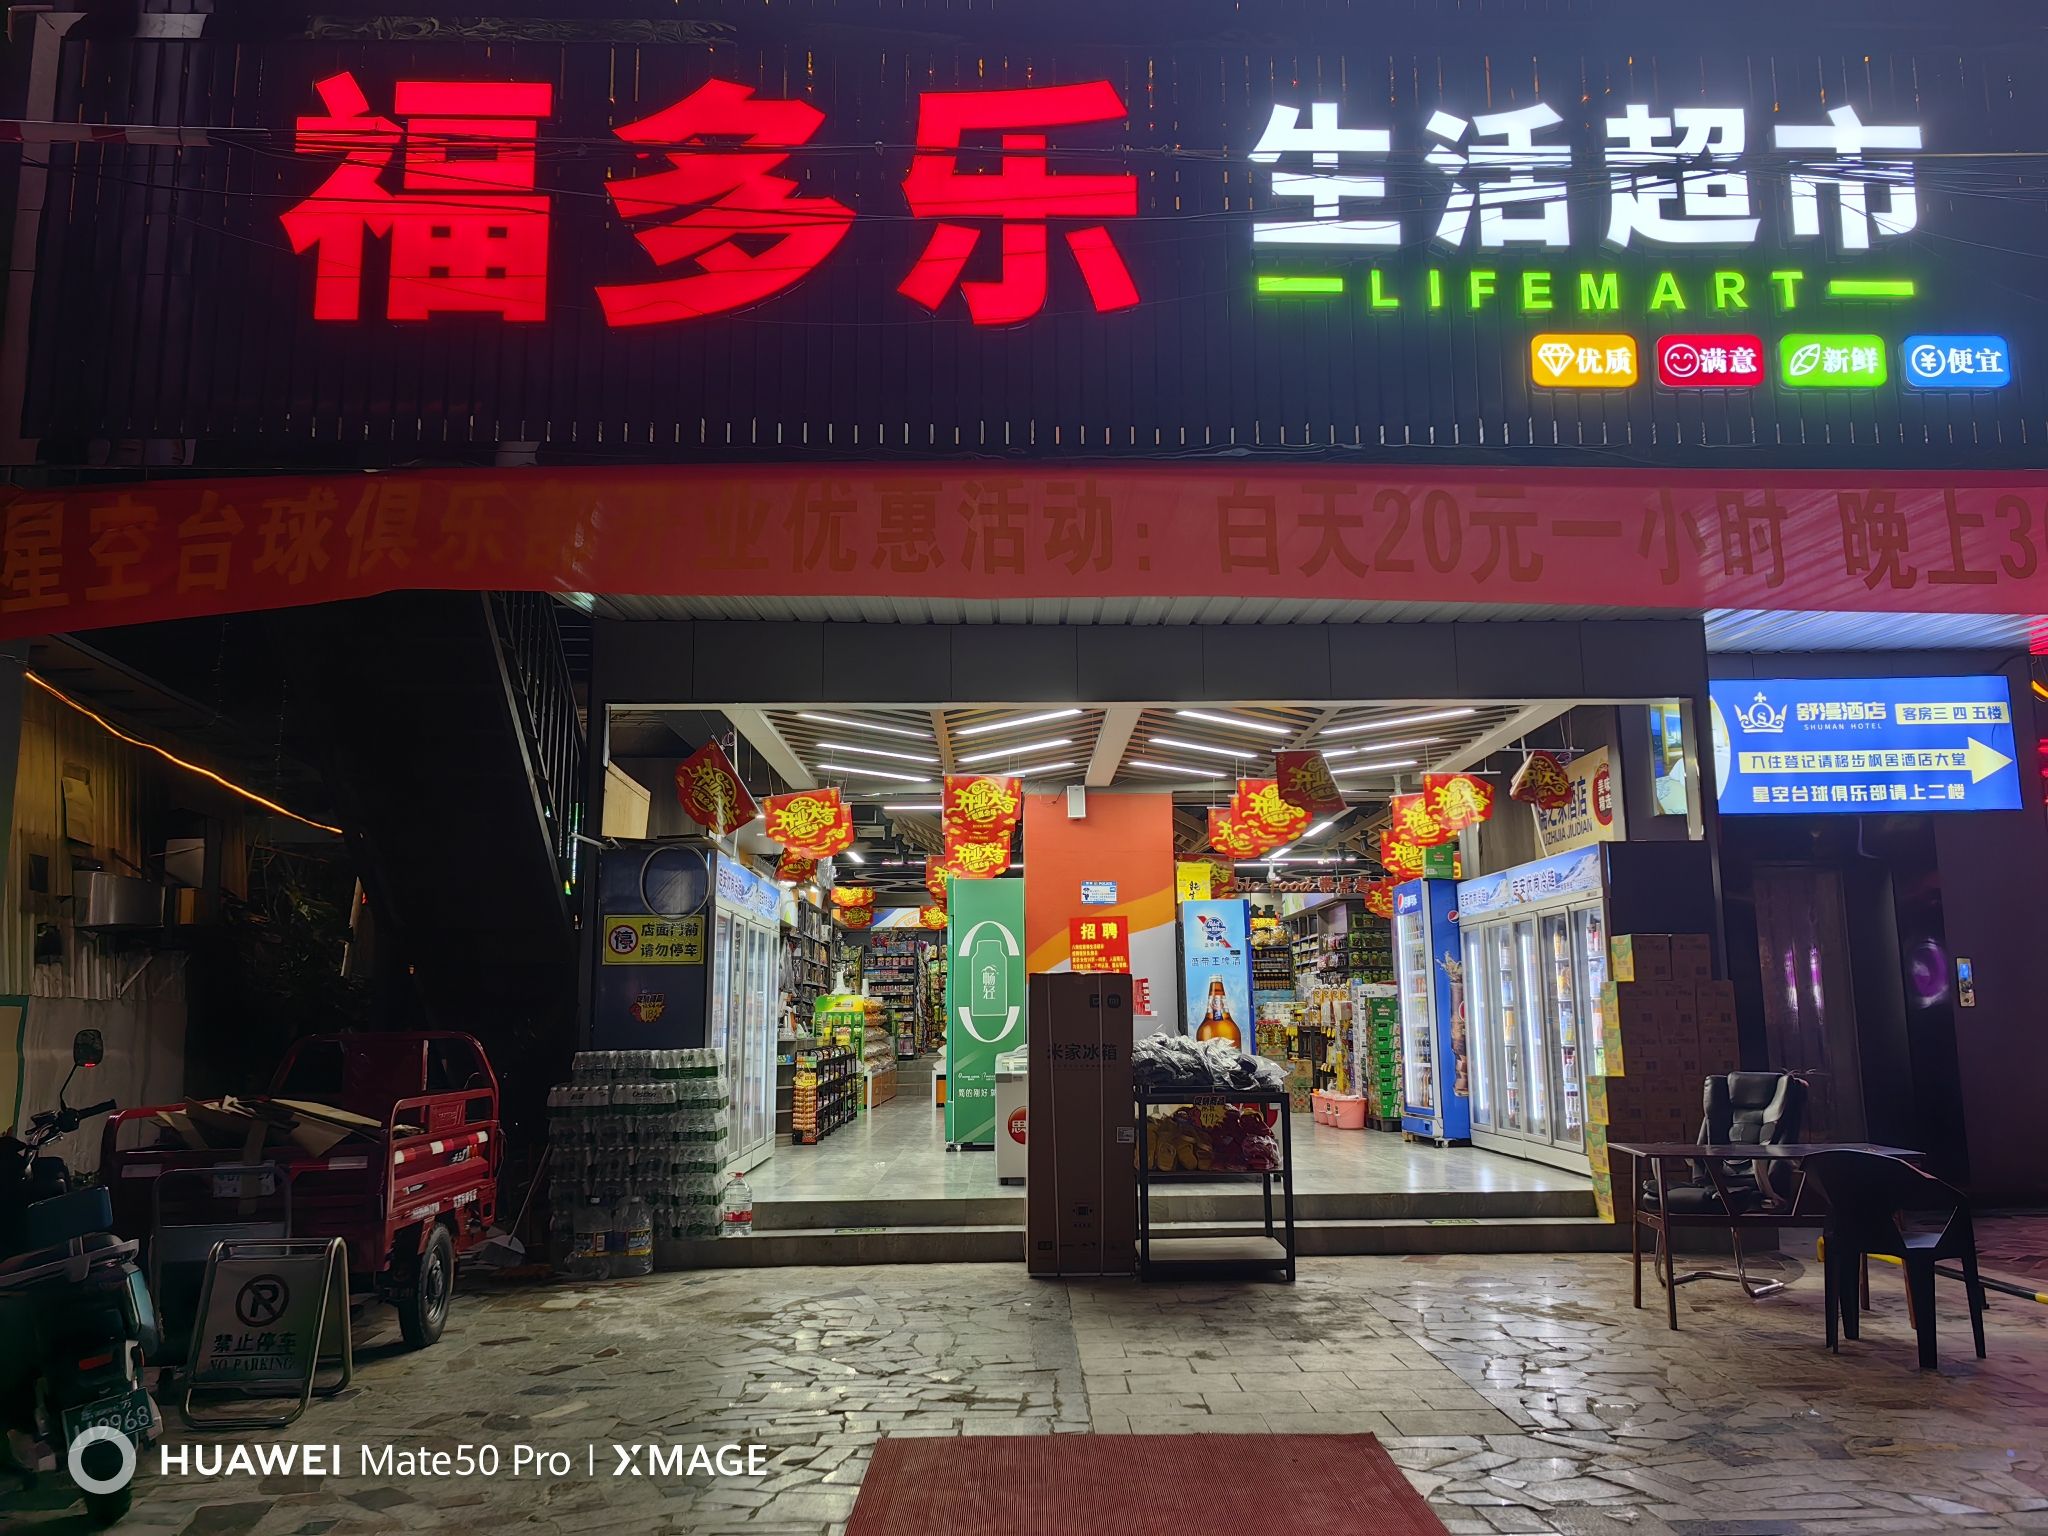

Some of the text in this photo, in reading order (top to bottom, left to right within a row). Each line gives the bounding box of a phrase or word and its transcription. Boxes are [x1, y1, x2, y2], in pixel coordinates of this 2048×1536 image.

[1248, 103, 1924, 249] 生活超市
[280, 71, 1140, 327] 福多乐
[1371, 270, 1805, 310] LIFEMART
[1576, 347, 1633, 376] 优质
[1699, 347, 1757, 376] 满意
[1821, 347, 1879, 376] 新鲜
[1947, 347, 2004, 376] 便宜
[1841, 486, 2048, 590] 晚上3
[1797, 702, 1887, 721] 舒漫酒店
[951, 788, 1019, 814] 开业大吉
[1752, 783, 1966, 803] 星空台球俱乐部请上二楼
[770, 804, 838, 831] 开业大吉
[952, 844, 1008, 865] 开业大吉
[641, 922, 699, 937] 店面门前
[1081, 922, 1118, 940] 招聘
[641, 943, 698, 957] 请勿停车
[1047, 1043, 1117, 1061] 米家冰箱
[213, 1331, 297, 1353] 禁止停车
